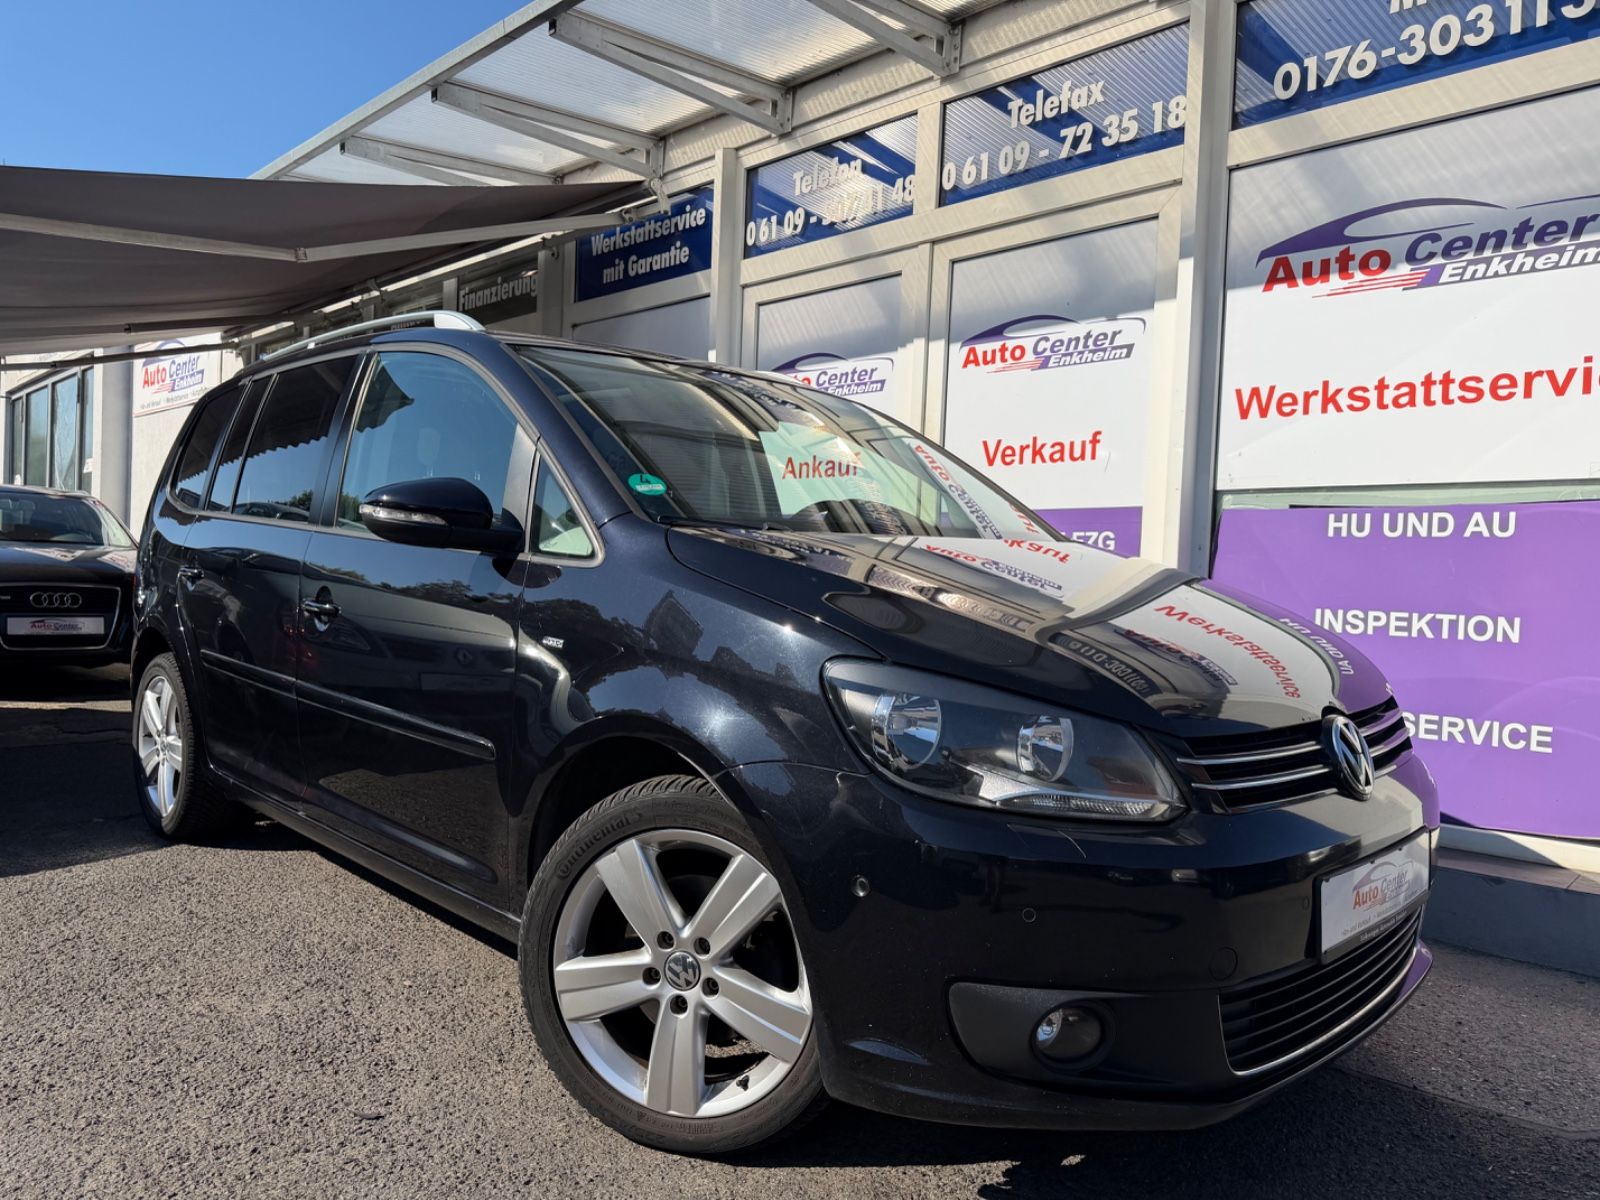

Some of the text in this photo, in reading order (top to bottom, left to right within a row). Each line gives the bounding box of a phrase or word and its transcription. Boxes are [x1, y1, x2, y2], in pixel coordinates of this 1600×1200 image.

[1007, 80, 1105, 129] Telefax
[942, 161, 957, 190] 0
[962, 152, 988, 185] 61
[999, 141, 1030, 174] 09
[1059, 122, 1093, 158] 72
[1101, 108, 1138, 146] 35
[1152, 95, 1187, 133] 18
[793, 157, 861, 195] Telefon
[591, 205, 705, 255] Werkstattservice
[746, 222, 756, 246] 0
[759, 215, 777, 241] 61
[784, 207, 805, 236] 09
[602, 240, 690, 284] mit Garantie
[1262, 213, 1600, 291] Auto Center
[1440, 244, 1600, 282] Enkheim
[459, 275, 538, 311] Finanzierung
[962, 327, 1122, 368] Auto Center
[1049, 346, 1129, 367] Enkheim
[143, 355, 200, 388] Auto Center
[816, 367, 877, 387] Center
[1236, 355, 1600, 420] Werkstattservi
[982, 431, 1102, 467] Verkauf
[1328, 511, 1516, 538] HU UND AU
[1314, 608, 1520, 643] INSPEKTION
[1402, 712, 1553, 753] SERVICE
[1353, 885, 1380, 910] Auto
